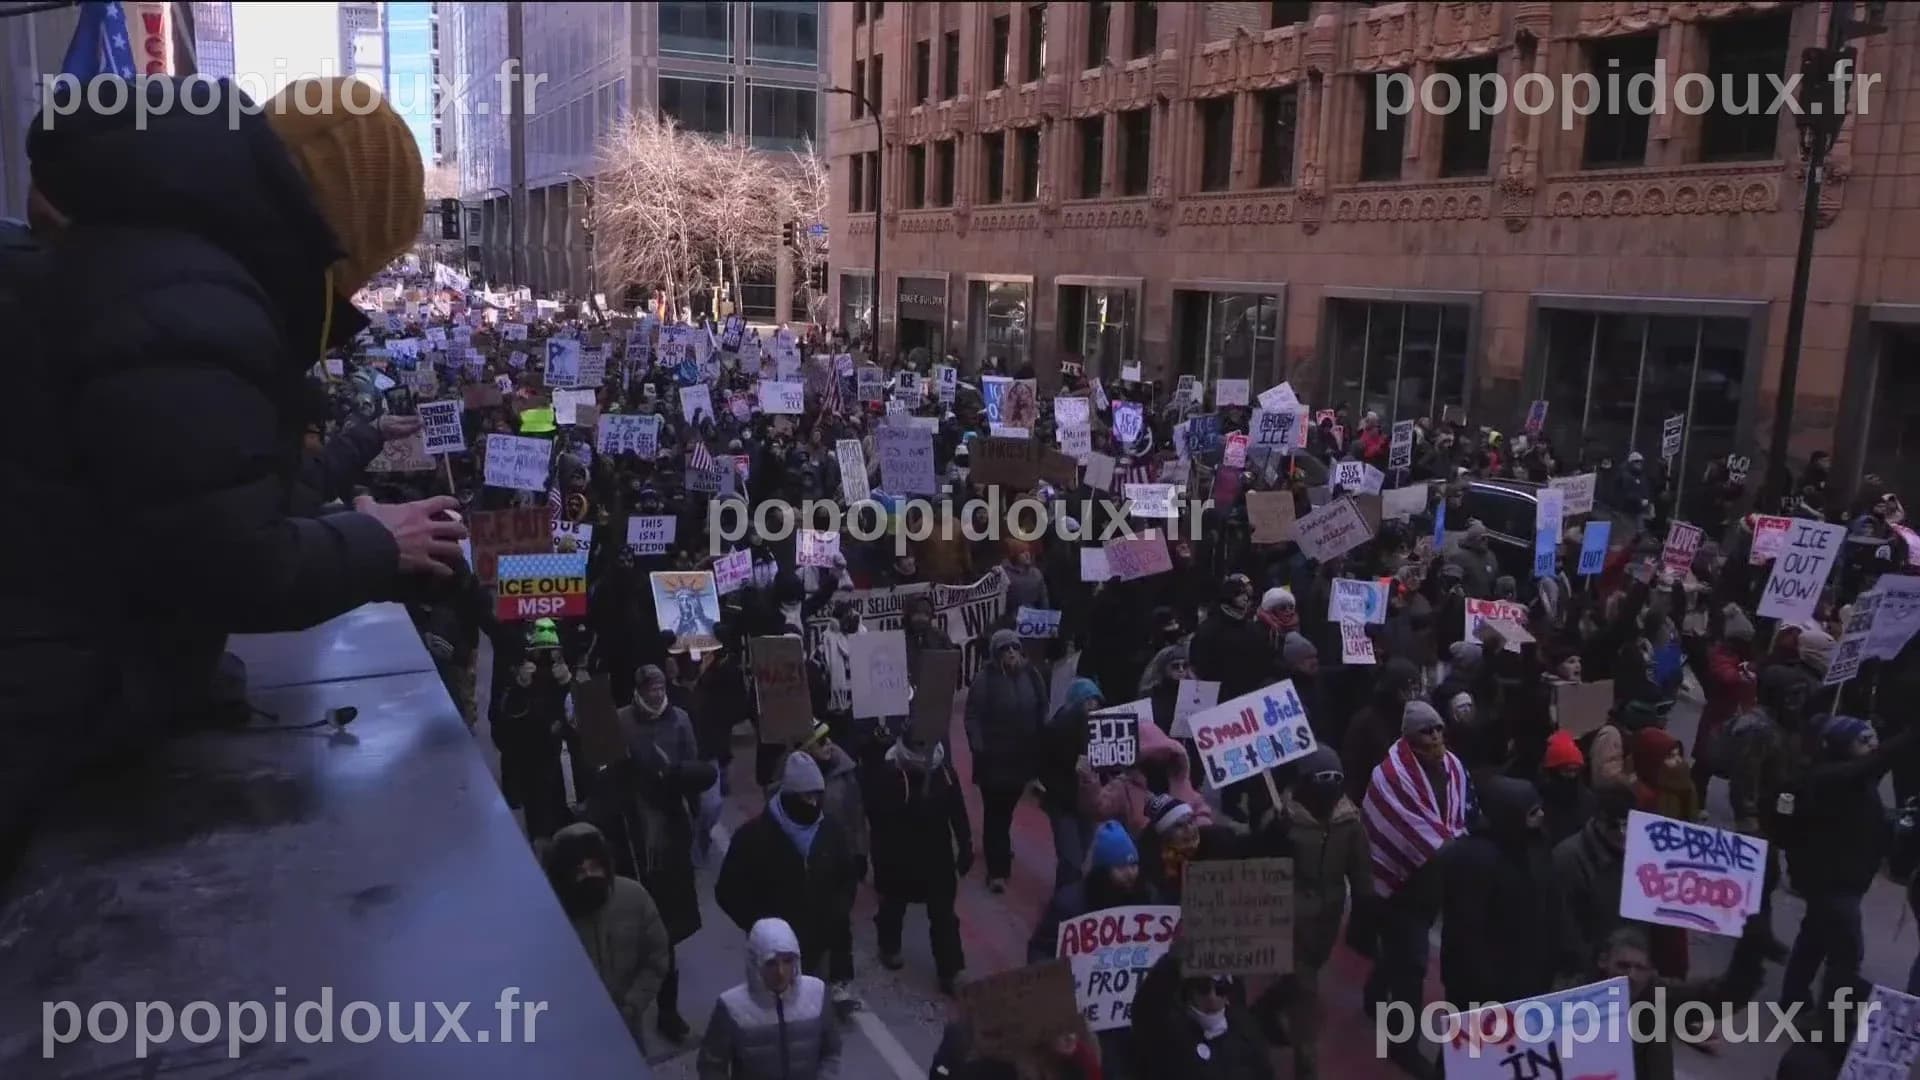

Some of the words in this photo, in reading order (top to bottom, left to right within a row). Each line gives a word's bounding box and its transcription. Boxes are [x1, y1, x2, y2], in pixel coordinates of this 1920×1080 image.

[901, 373, 914, 388] ICE
[1256, 429, 1290, 444] ICE
[641, 519, 663, 529] THIS
[1791, 526, 1832, 550] ICE
[1581, 550, 1602, 569] OUT
[1783, 553, 1825, 575] OUT
[499, 579, 532, 595] ICE
[539, 577, 583, 593] OUT
[1768, 576, 1818, 600] NOW!
[518, 597, 567, 616] MSP
[1263, 687, 1301, 727] dick
[1681, 828, 1760, 872] BRAVE
[1087, 968, 1146, 997] PROT
